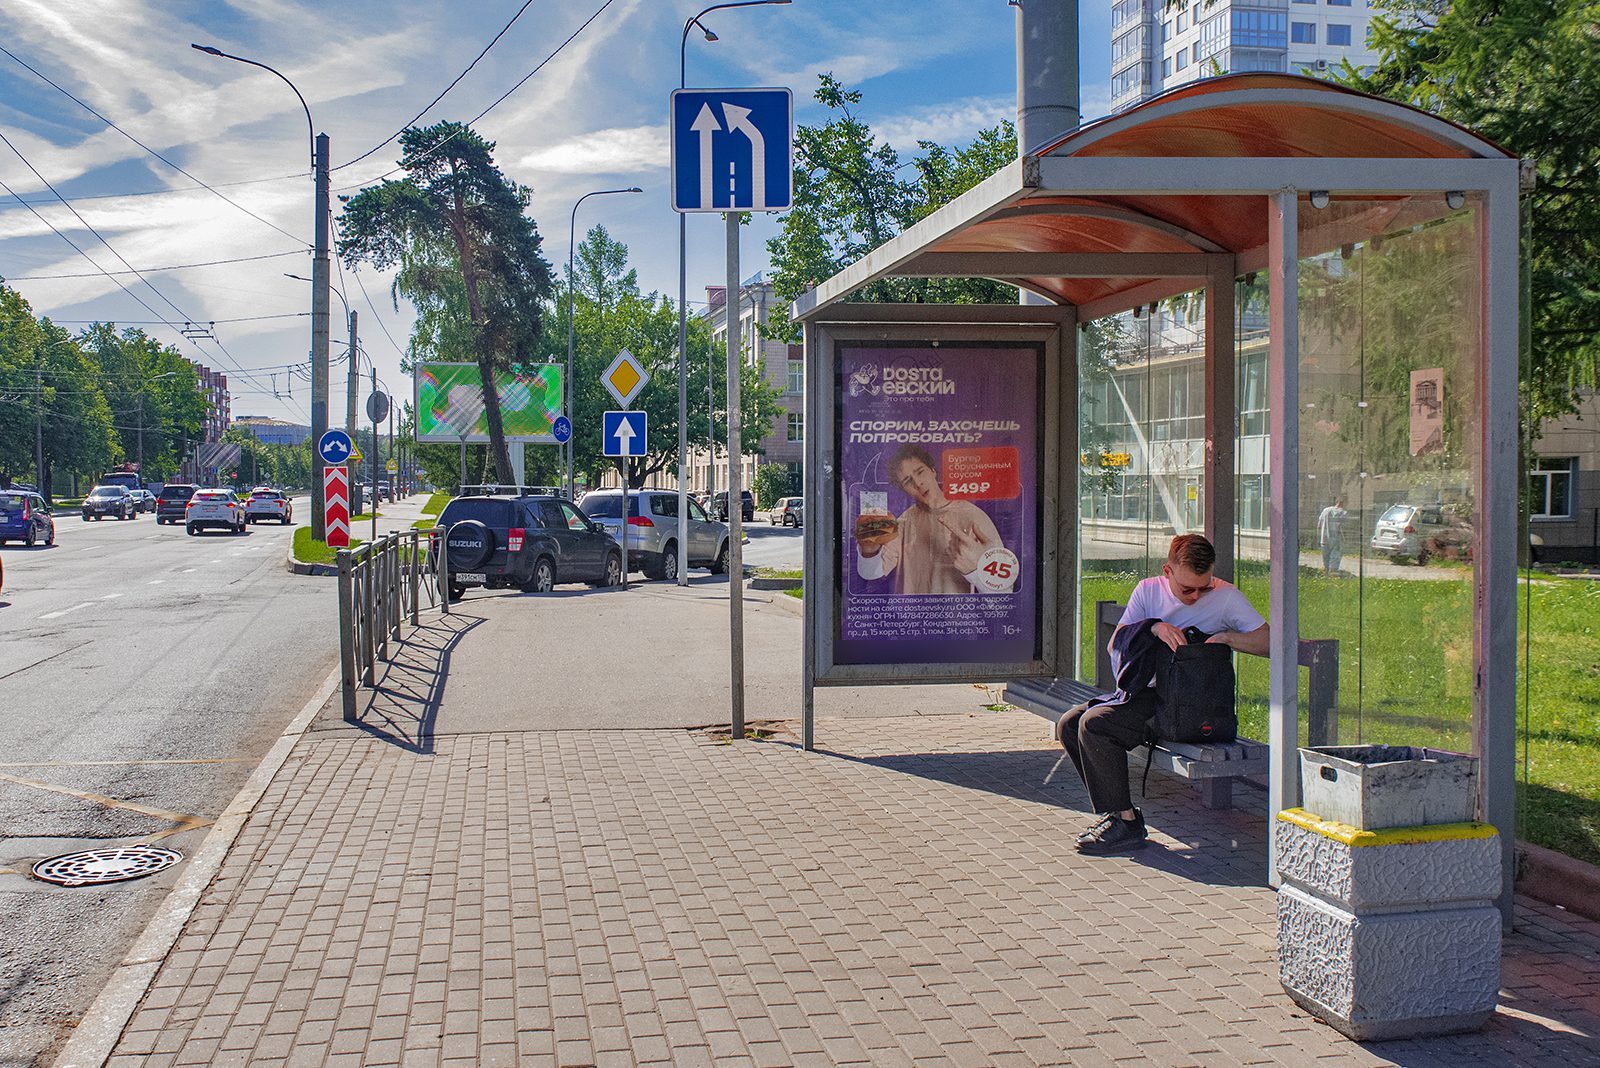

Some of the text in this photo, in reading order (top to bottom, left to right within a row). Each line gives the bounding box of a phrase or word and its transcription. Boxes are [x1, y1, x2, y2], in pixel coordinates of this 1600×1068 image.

[850, 420, 1021, 432] СПОРИМ, ЗАХОЧЕШЬ
[850, 432, 982, 443] ПОПРОБОВАТЬ?
[948, 454, 981, 463] Бургер
[954, 462, 1012, 471] брусничным
[948, 471, 982, 481] соусом
[449, 540, 482, 548] SUZUKI
[983, 561, 1012, 579] 45
[887, 597, 923, 605] доставки
[955, 603, 975, 611] ООО
[873, 612, 896, 620] ОГРН
[923, 619, 985, 628] Кондратьевский
[1002, 624, 1022, 635] 16+
